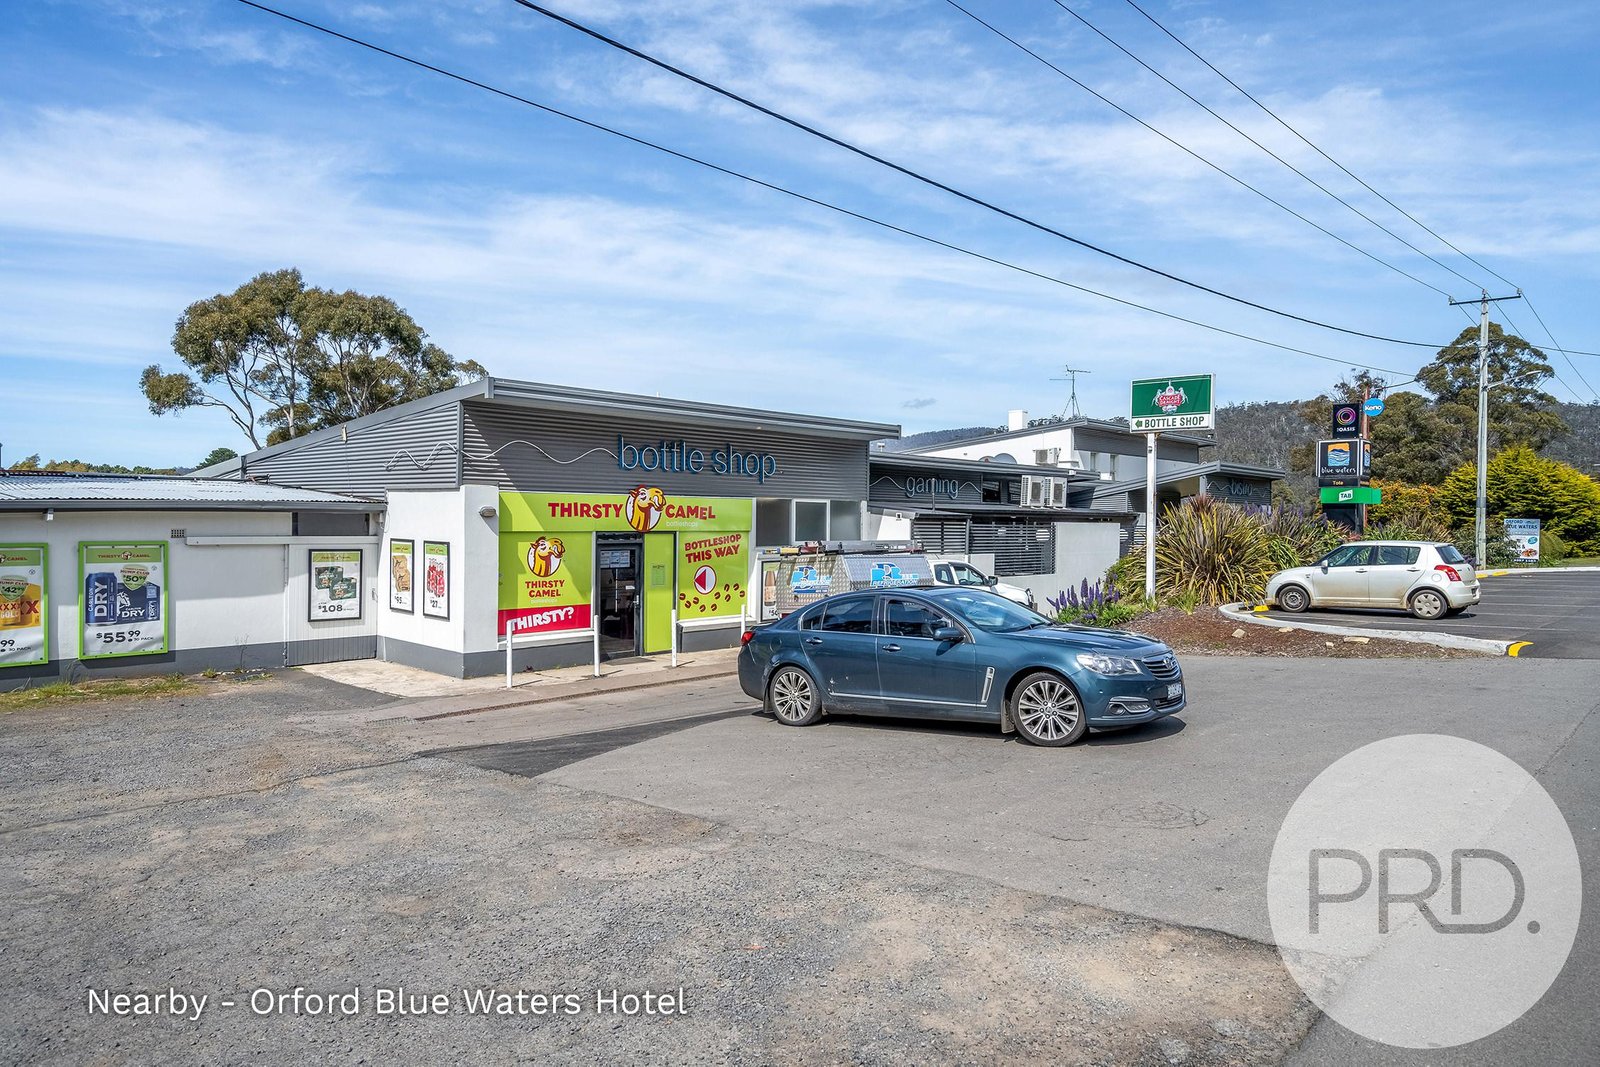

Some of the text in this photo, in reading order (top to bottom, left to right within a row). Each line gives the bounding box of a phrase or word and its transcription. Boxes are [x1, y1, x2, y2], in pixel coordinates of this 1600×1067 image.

[1144, 415, 1205, 428] BOTTLE SHOP
[617, 433, 780, 484] bottle shop
[1321, 466, 1334, 475] blue
[1335, 466, 1356, 475] waters
[905, 474, 959, 499] gaming
[547, 501, 717, 521] THIRSTY CAMEL
[684, 533, 742, 552] BOTTLESHOP
[685, 544, 741, 564] THIS WAY
[524, 579, 565, 589] THIRSTY
[528, 589, 561, 598] CAMEL
[95, 581, 108, 617] DRY
[318, 604, 343, 613] $108
[121, 610, 145, 618] DRY
[509, 606, 575, 631] THIRSTY?
